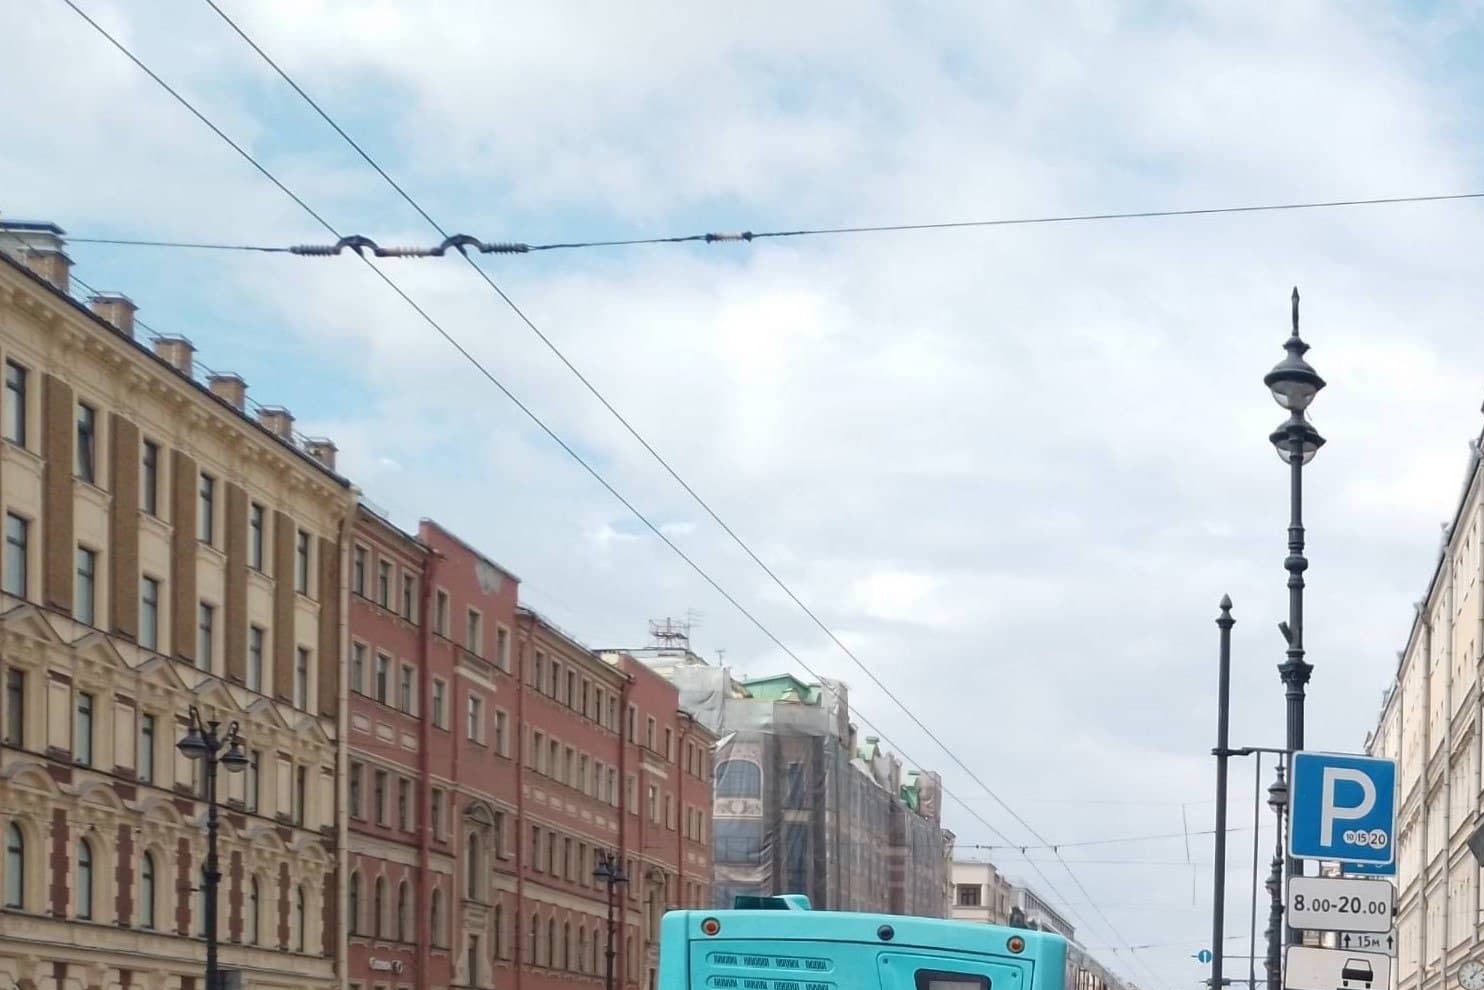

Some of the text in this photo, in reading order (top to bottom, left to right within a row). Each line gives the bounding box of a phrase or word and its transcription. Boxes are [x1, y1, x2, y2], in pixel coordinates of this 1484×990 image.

[1319, 766, 1377, 847] P
[1370, 833, 1386, 845] 20
[1294, 894, 1386, 915] 8.00-20.00
[1358, 935, 1381, 948] 15м
